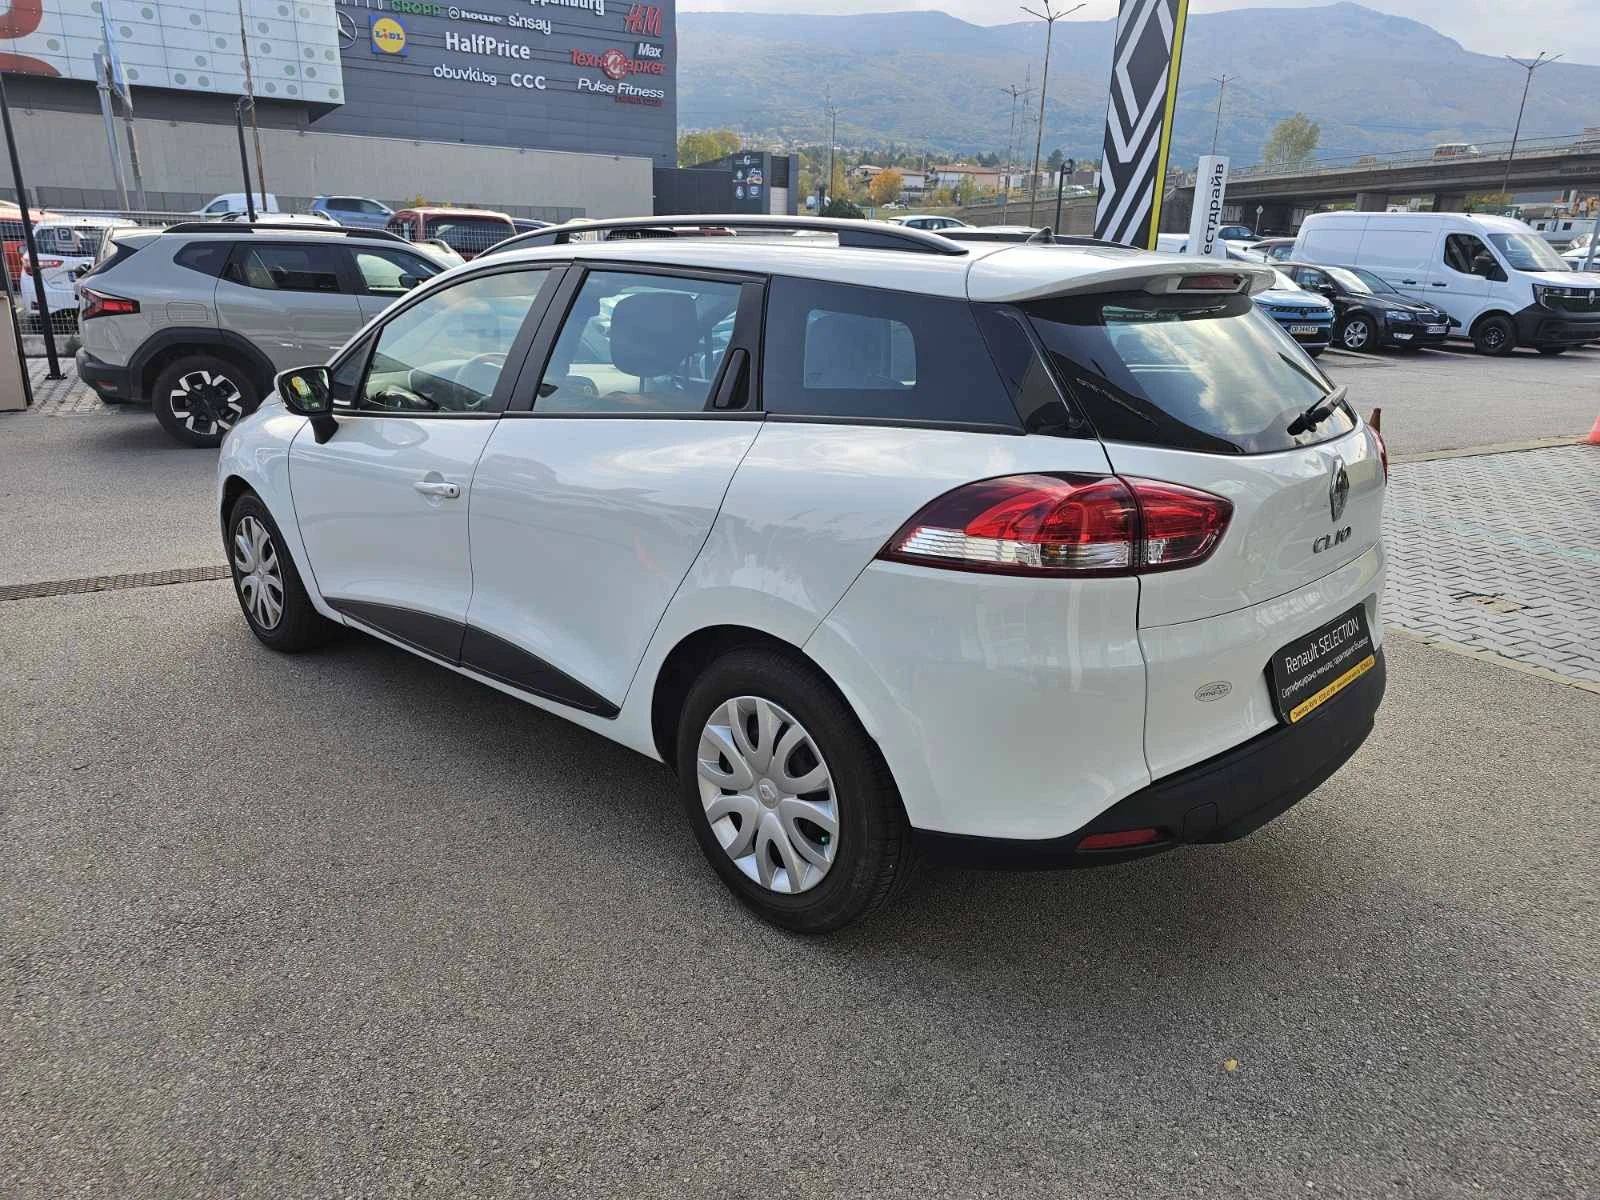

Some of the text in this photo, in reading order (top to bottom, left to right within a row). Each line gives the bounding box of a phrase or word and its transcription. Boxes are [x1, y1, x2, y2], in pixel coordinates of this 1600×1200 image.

[508, 12, 552, 35] sinsay
[445, 31, 530, 59] HalfPrice
[638, 43, 663, 57] Max
[433, 64, 497, 86] obuvki.bg
[511, 73, 546, 89] CCC
[577, 78, 664, 98] Pulse Fitness
[1202, 163, 1224, 255] естдрайв
[1312, 526, 1351, 553] CLIO
[1285, 617, 1359, 674] Renault SELECTION
